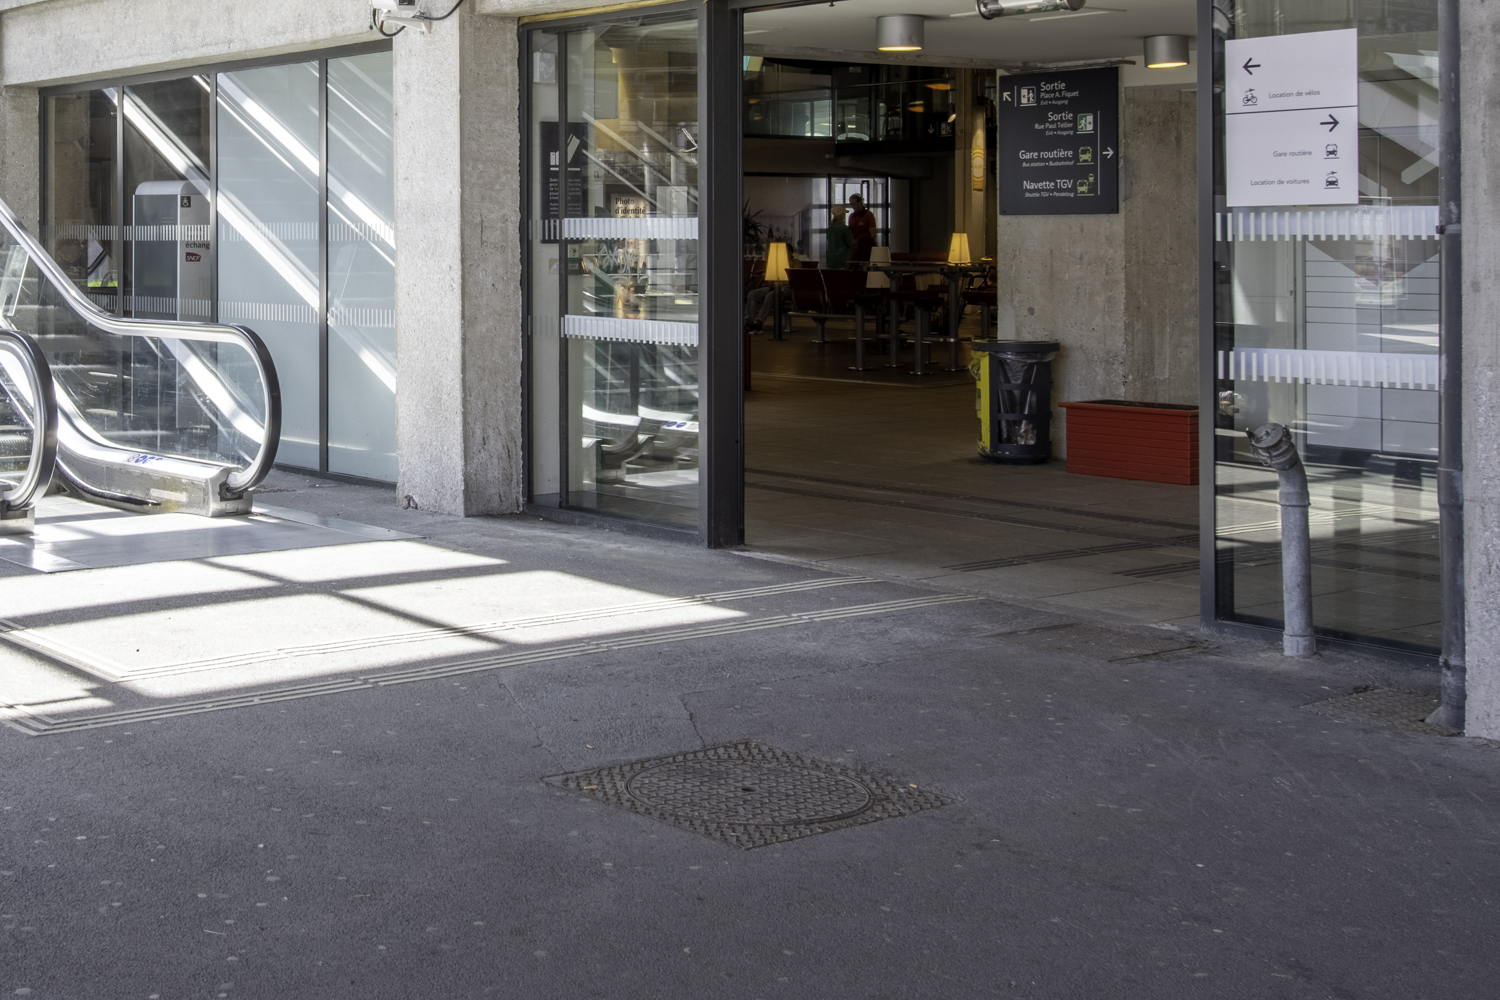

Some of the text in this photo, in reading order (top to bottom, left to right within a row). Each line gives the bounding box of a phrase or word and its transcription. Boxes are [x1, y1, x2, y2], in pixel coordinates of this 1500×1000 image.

[1040, 81, 1066, 91] Sortie
[1048, 111, 1073, 121] Sortie
[1019, 149, 1073, 159] Gare routière
[1023, 180, 1073, 189] Navette TGV
[615, 206, 646, 214] d'identité
